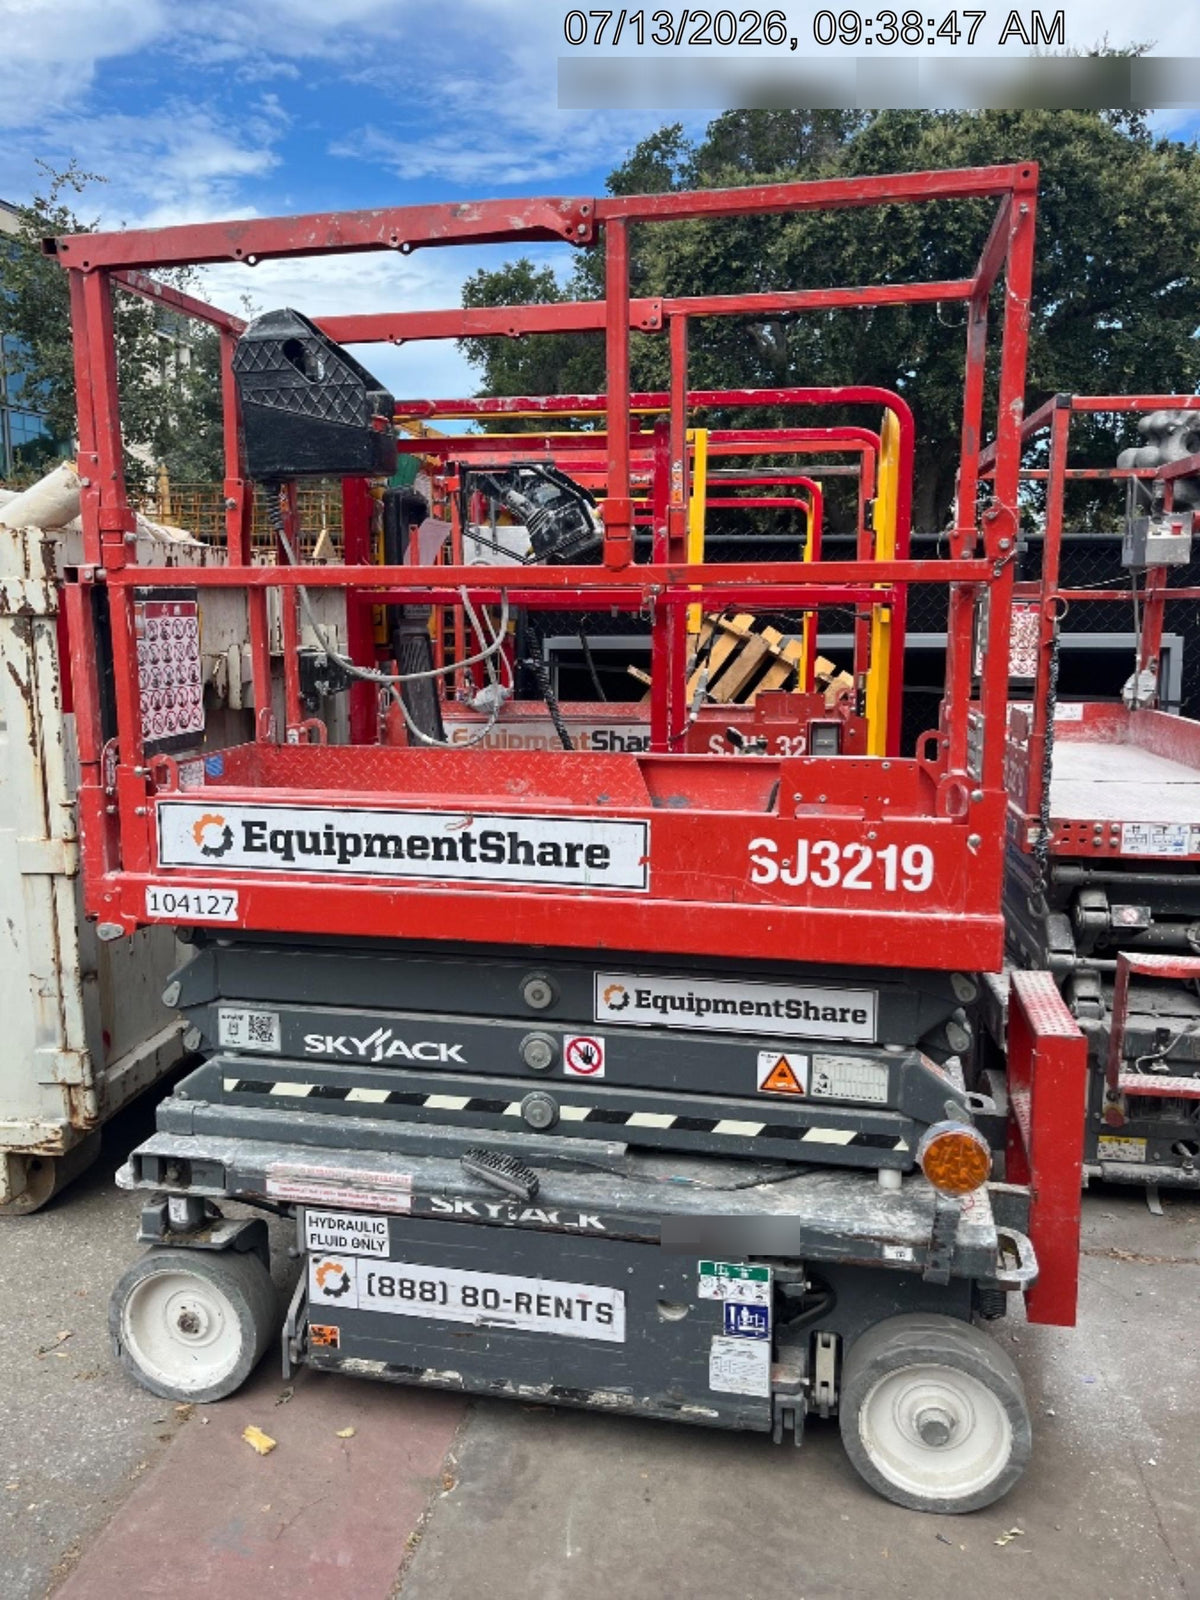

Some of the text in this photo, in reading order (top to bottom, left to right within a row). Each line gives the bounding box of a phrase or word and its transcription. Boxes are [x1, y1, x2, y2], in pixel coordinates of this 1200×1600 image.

[242, 821, 611, 870] EquipmentShare
[748, 838, 934, 892] SJ3219
[149, 893, 235, 916] 104127
[635, 989, 867, 1025] EquipmentShare
[304, 1028, 467, 1063] SKYJACK
[308, 1215, 385, 1235] HYDRAULIC
[310, 1233, 385, 1252] FLUID ONLY
[367, 1272, 614, 1325] (888) 80-RENTS
